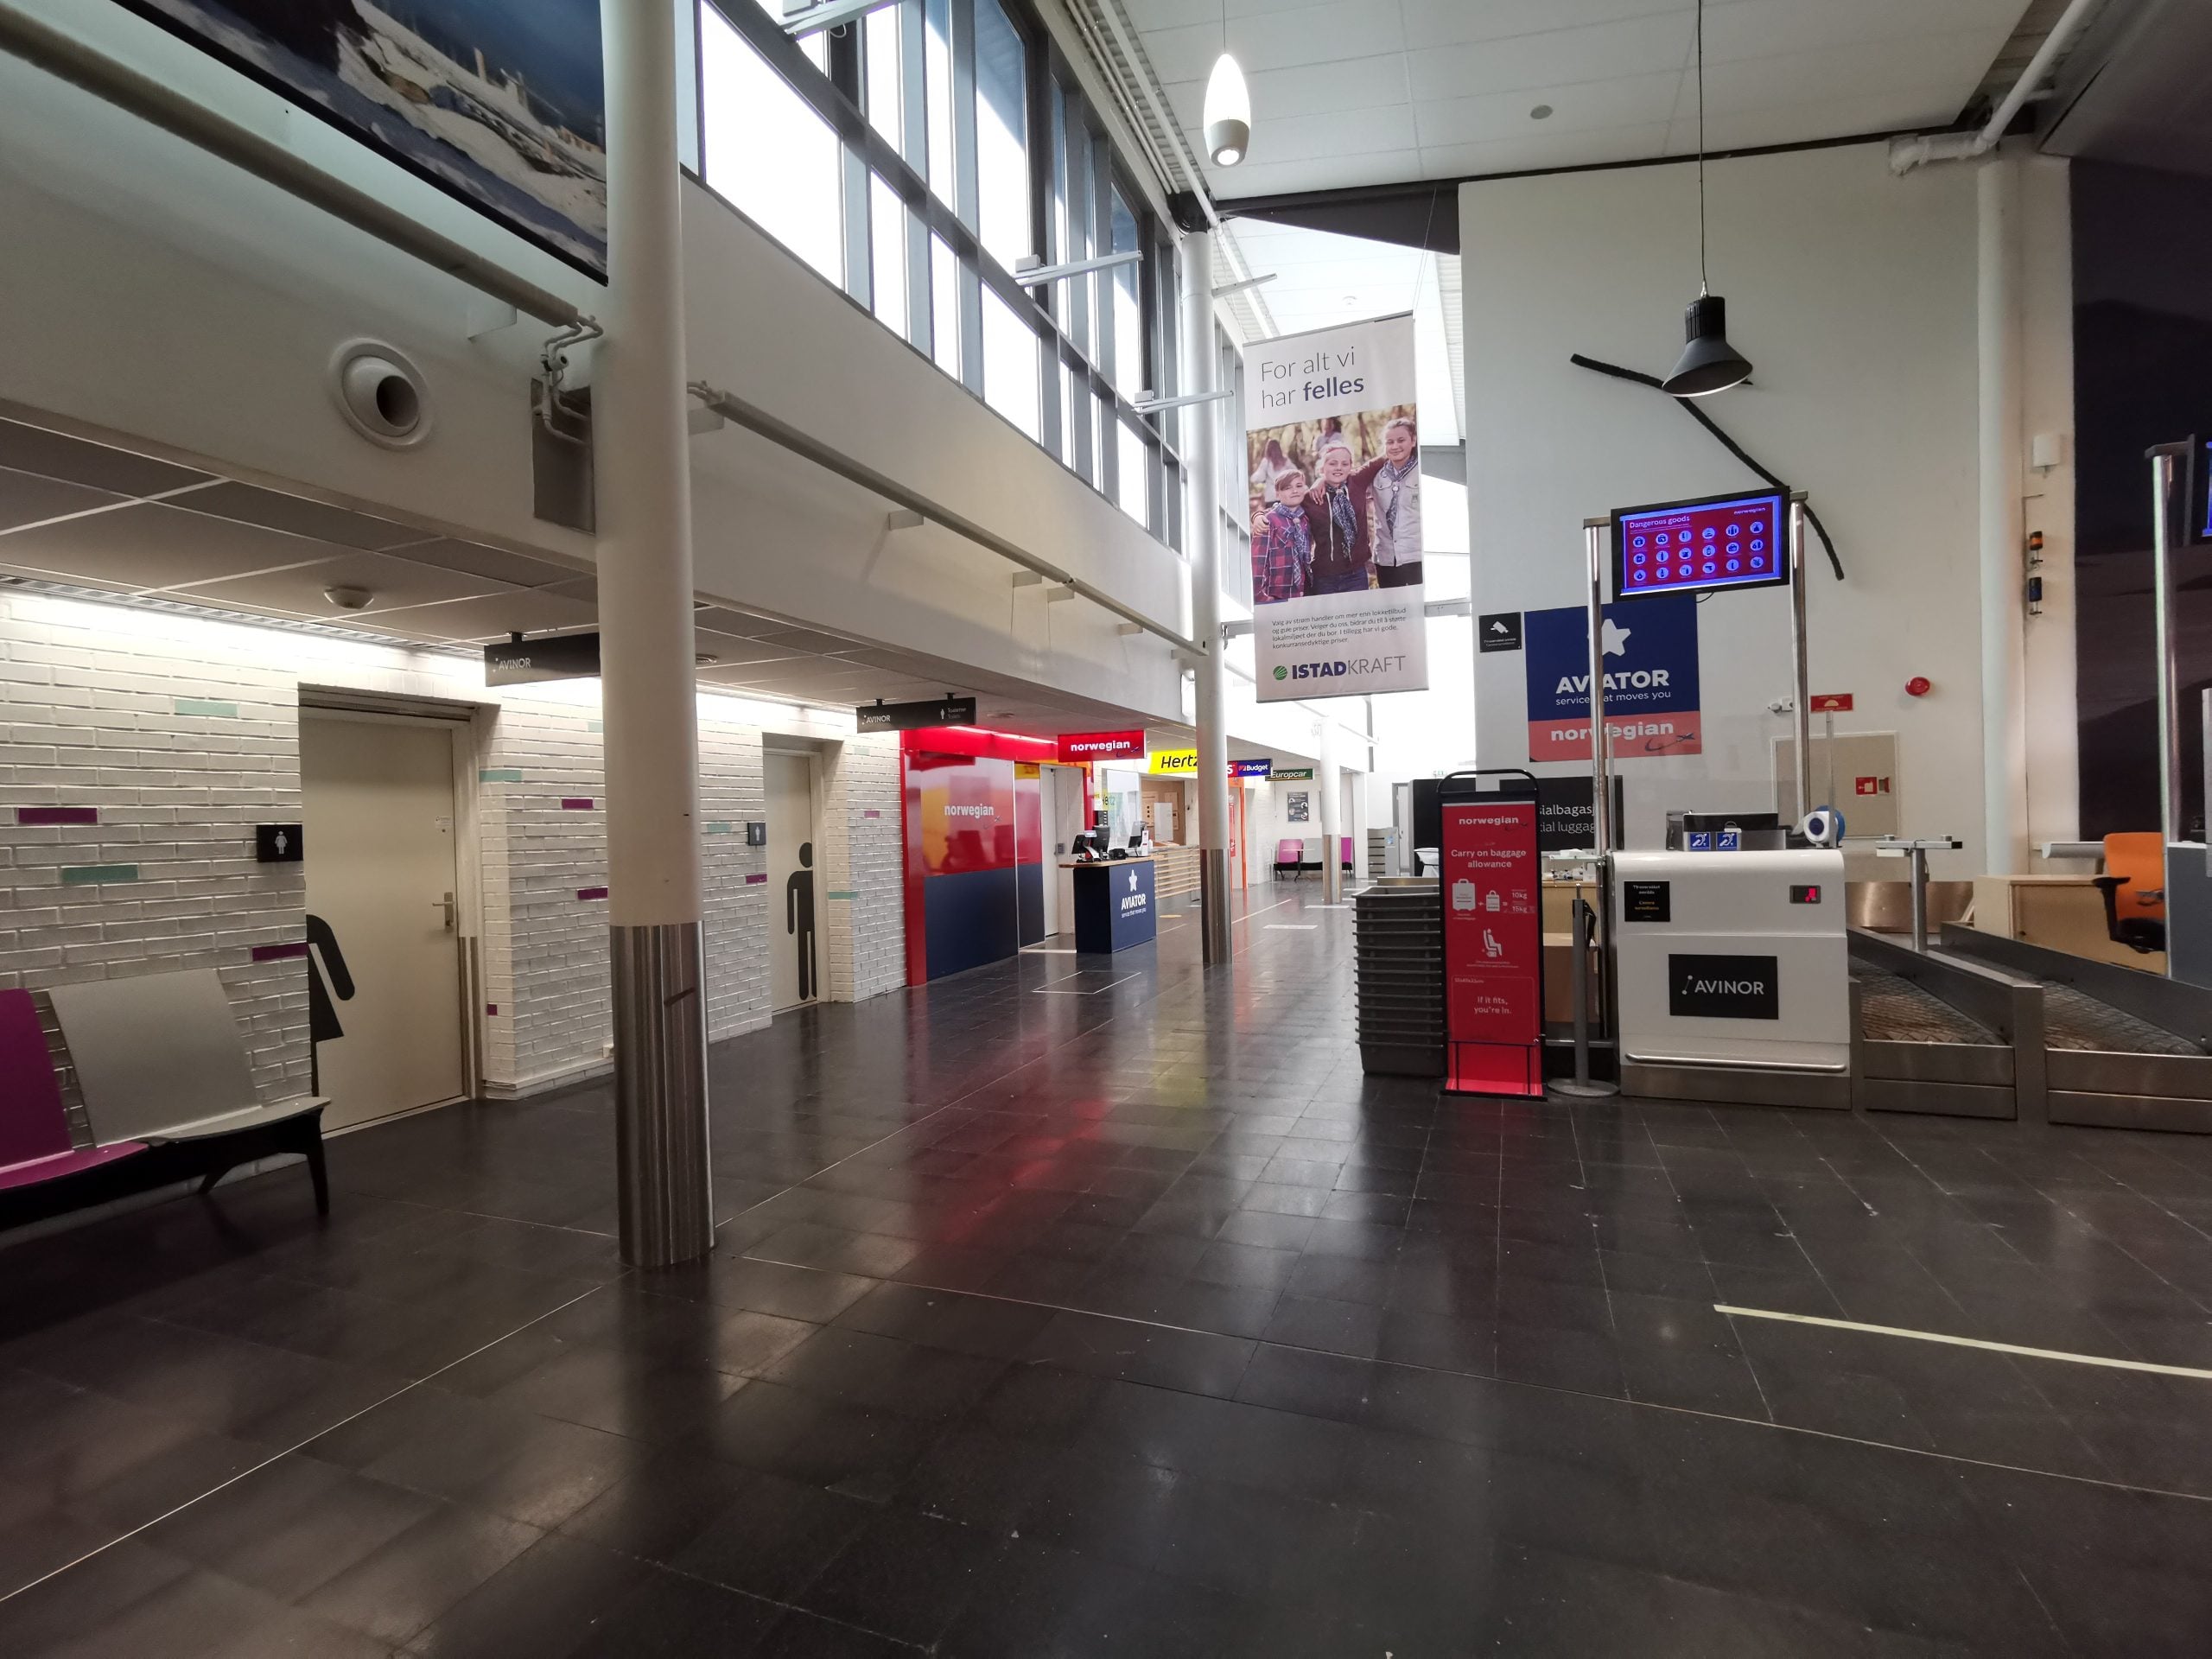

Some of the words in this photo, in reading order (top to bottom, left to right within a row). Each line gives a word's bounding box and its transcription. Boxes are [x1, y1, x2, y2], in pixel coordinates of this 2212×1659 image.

[1261, 360, 1296, 382] For
[1303, 353, 1331, 374] alt
[1337, 346, 1354, 367] vi
[1262, 390, 1296, 409] har
[1303, 376, 1364, 402] felles
[1630, 518, 1667, 529] Dangerous
[1668, 515, 1690, 525] goods
[1372, 607, 1407, 616] lokketilbud
[499, 658, 531, 671] AVINOR
[1555, 669, 1670, 694] AVATOR
[1616, 693, 1649, 702] moves
[1652, 691, 1671, 700] you
[866, 715, 891, 724] AVINOR
[1071, 740, 1130, 752] norwegian
[1247, 764, 1268, 773] Budget
[1270, 770, 1307, 779] Europcar
[944, 803, 995, 819] norwegian
[1459, 816, 1519, 825] norwegian
[1451, 849, 1476, 858] Carry
[1490, 849, 1527, 858] baggage
[1121, 893, 1147, 911] AVIATOR
[1512, 892, 1528, 900] 10kg
[1694, 980, 1764, 995] AVINOR
